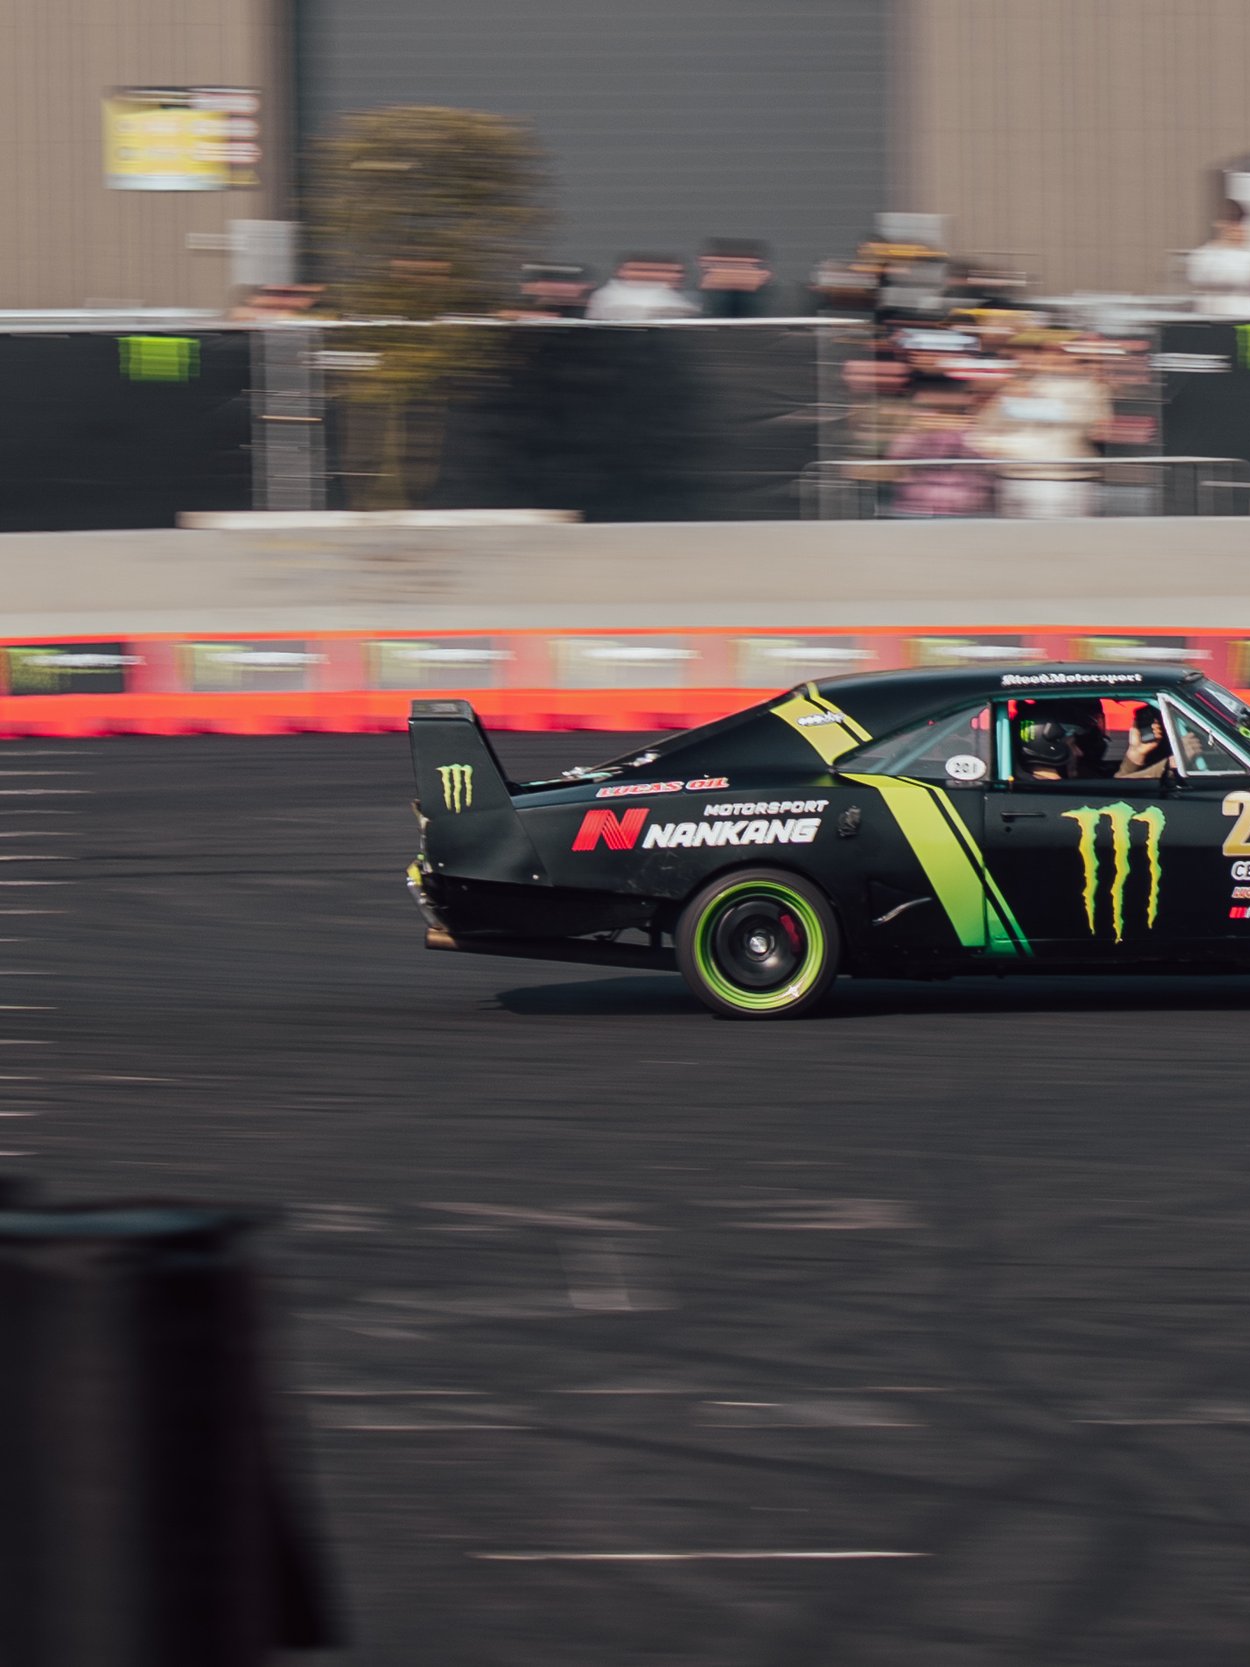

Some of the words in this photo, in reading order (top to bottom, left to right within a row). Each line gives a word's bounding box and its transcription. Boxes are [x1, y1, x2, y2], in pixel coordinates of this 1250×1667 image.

[596, 781, 684, 797] LUCAS
[686, 777, 729, 790] OIL
[704, 800, 829, 816] MOTORSPORT
[642, 818, 822, 849] NANKANG
